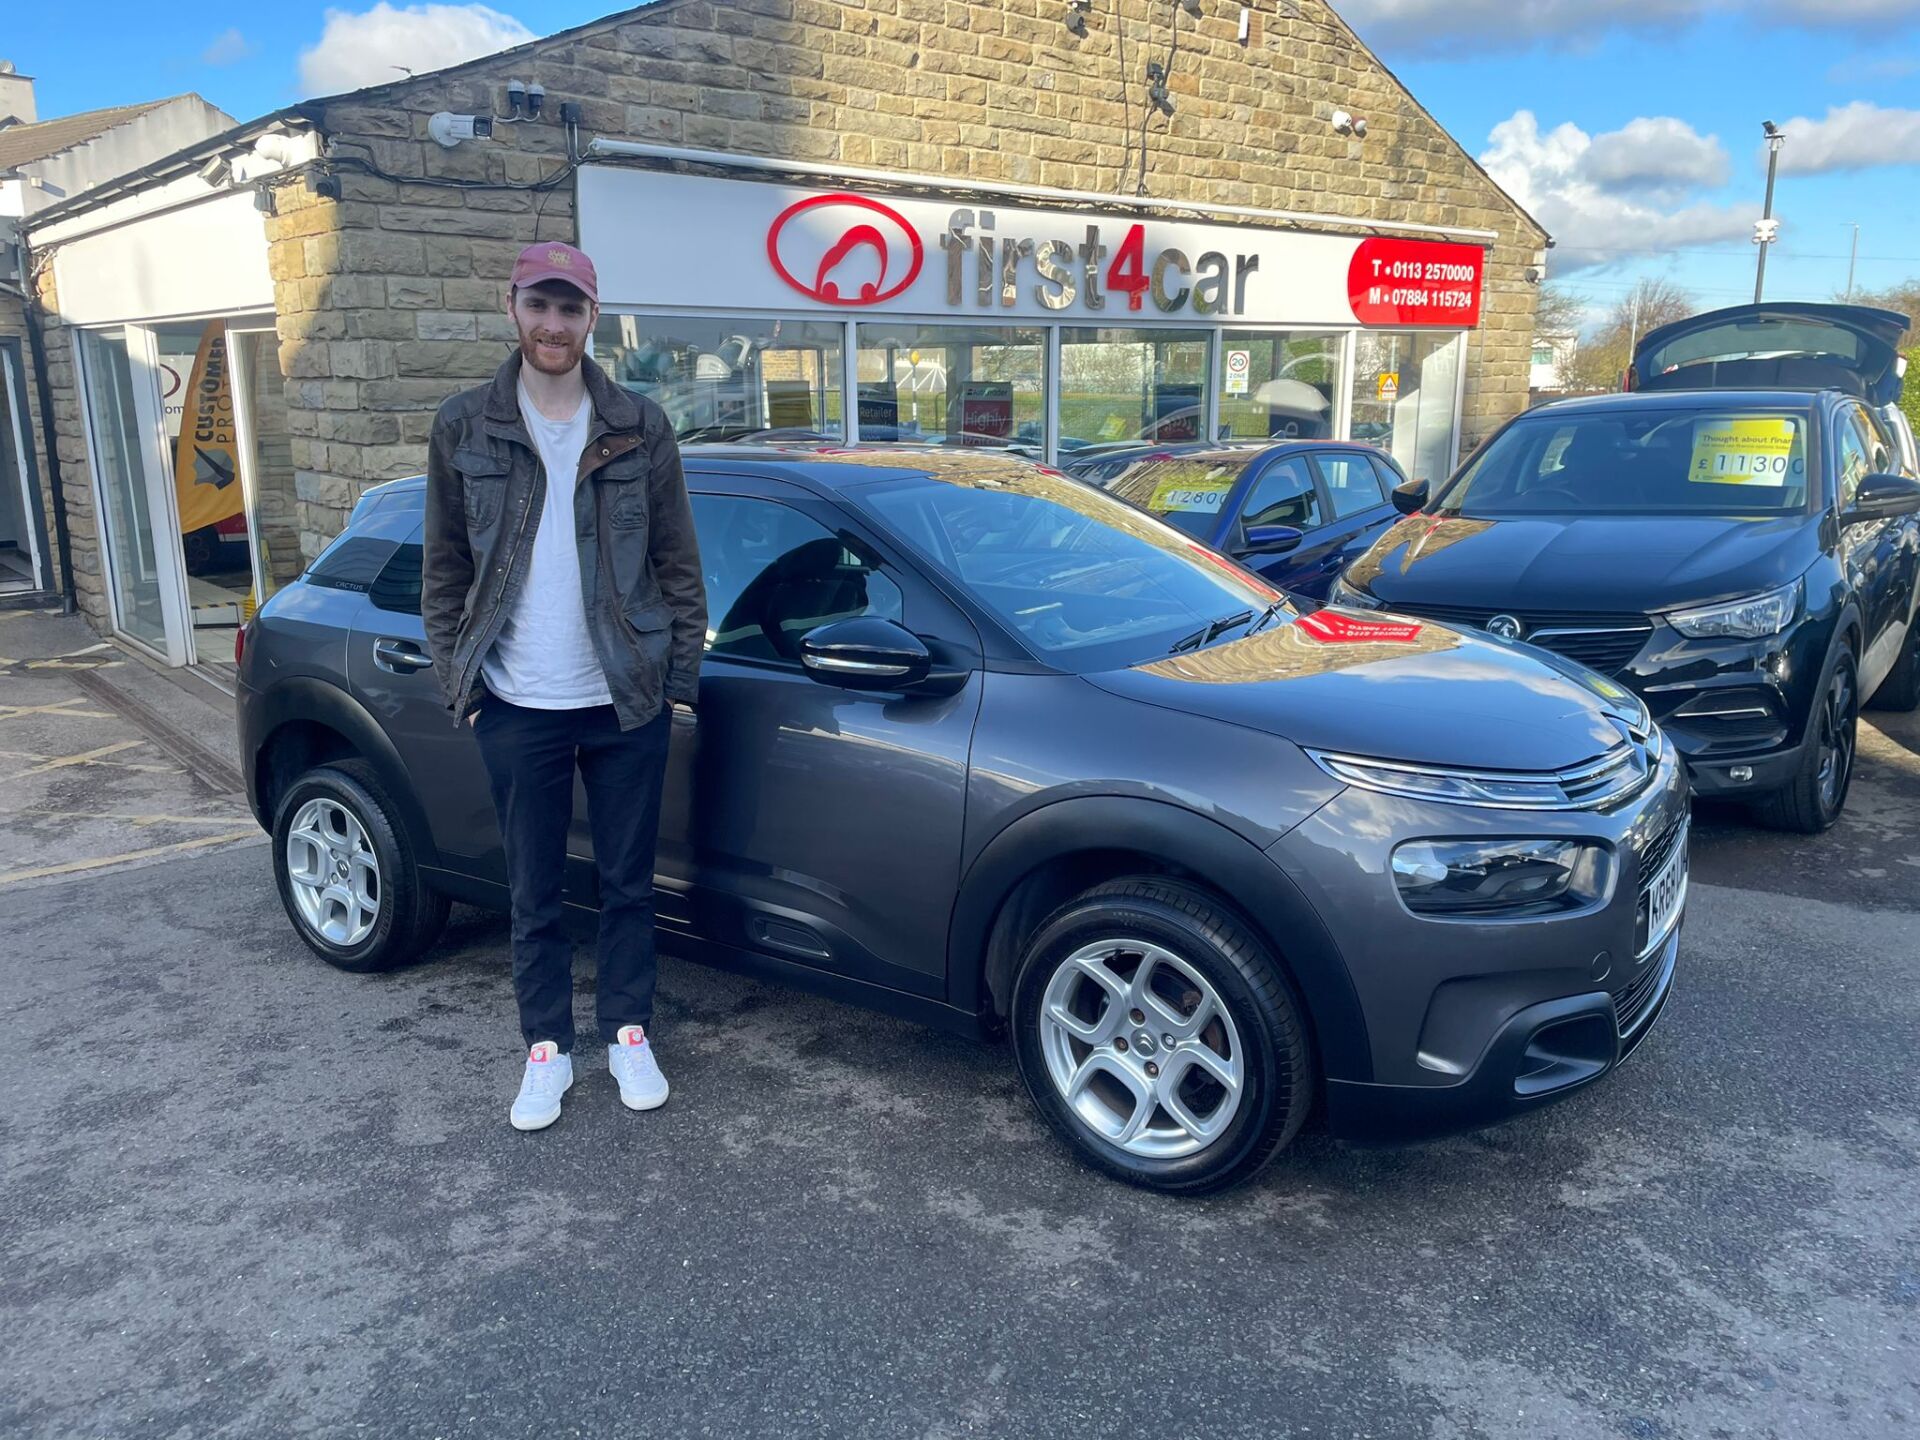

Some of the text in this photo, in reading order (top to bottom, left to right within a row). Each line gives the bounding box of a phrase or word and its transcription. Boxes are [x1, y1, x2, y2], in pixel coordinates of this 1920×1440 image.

[939, 208, 1260, 315] first4car
[1371, 259, 1474, 282] T 0113 2570000
[1368, 287, 1472, 308] M 07884 115724
[1231, 357, 1245, 367] 20
[859, 405, 893, 418] Retailer
[964, 410, 1006, 436] Highly
[1703, 434, 1739, 444] Thought
[1741, 436, 1768, 444] about
[335, 581, 364, 591] CACTUS
